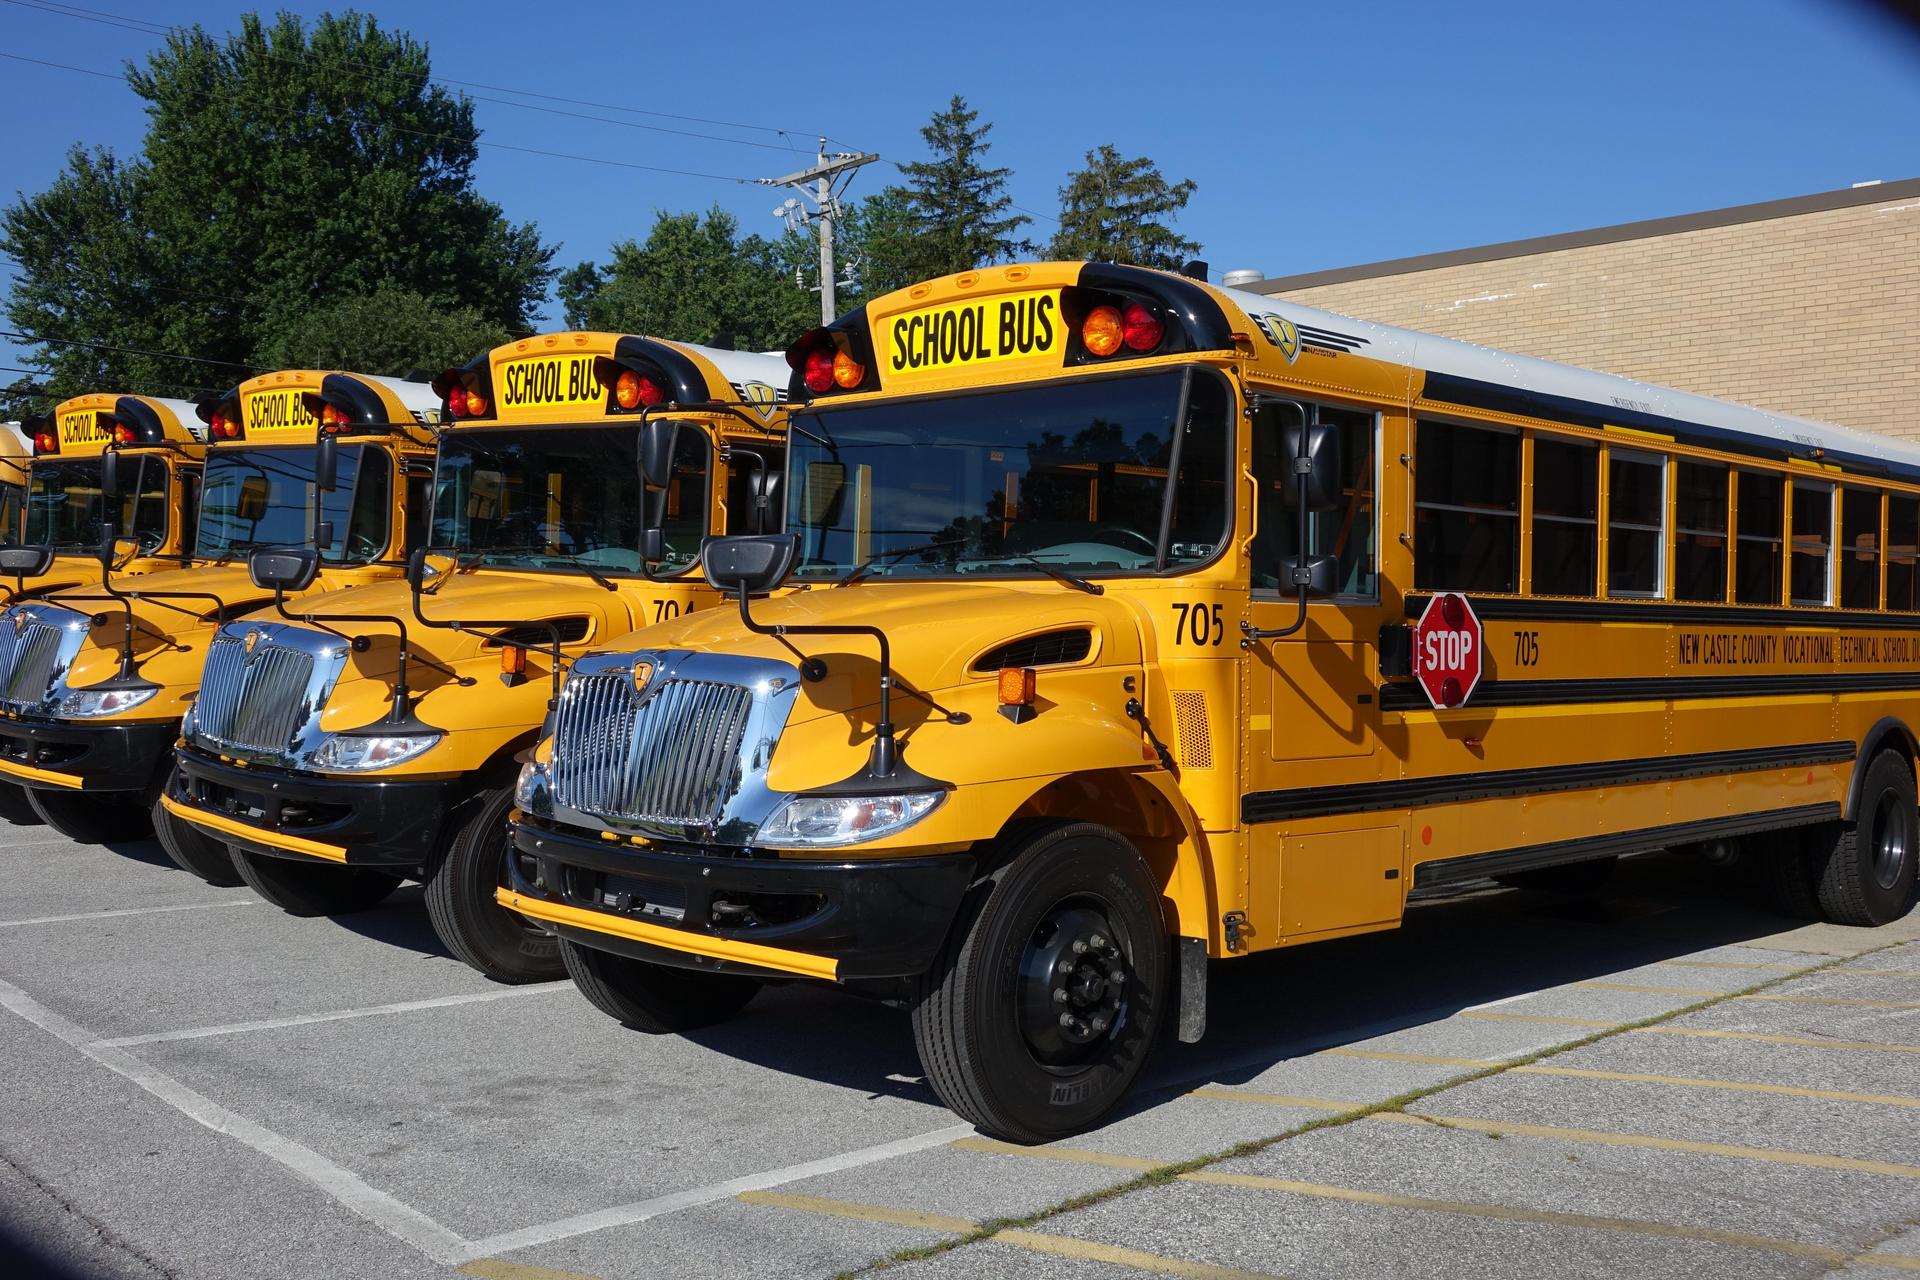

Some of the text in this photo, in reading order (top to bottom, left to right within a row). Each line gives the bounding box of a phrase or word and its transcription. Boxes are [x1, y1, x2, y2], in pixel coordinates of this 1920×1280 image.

[892, 295, 1054, 371] SCHOOL BUS
[505, 361, 564, 405] SCHOOL
[64, 413, 93, 443] SCHOOL
[250, 393, 289, 429] SCHOOL
[653, 599, 694, 624] 704
[1172, 602, 1224, 646] 705
[1426, 630, 1472, 671] STOP
[1514, 631, 1539, 667] 705
[1680, 633, 1700, 665] NEW
[1703, 633, 1738, 664] CASTLE
[1741, 634, 1777, 664] COUNTY
[1783, 635, 1834, 664] VOCATIONAL
[1840, 636, 1880, 664] TECHNICAL
[1883, 637, 1910, 663] SCHOOL
